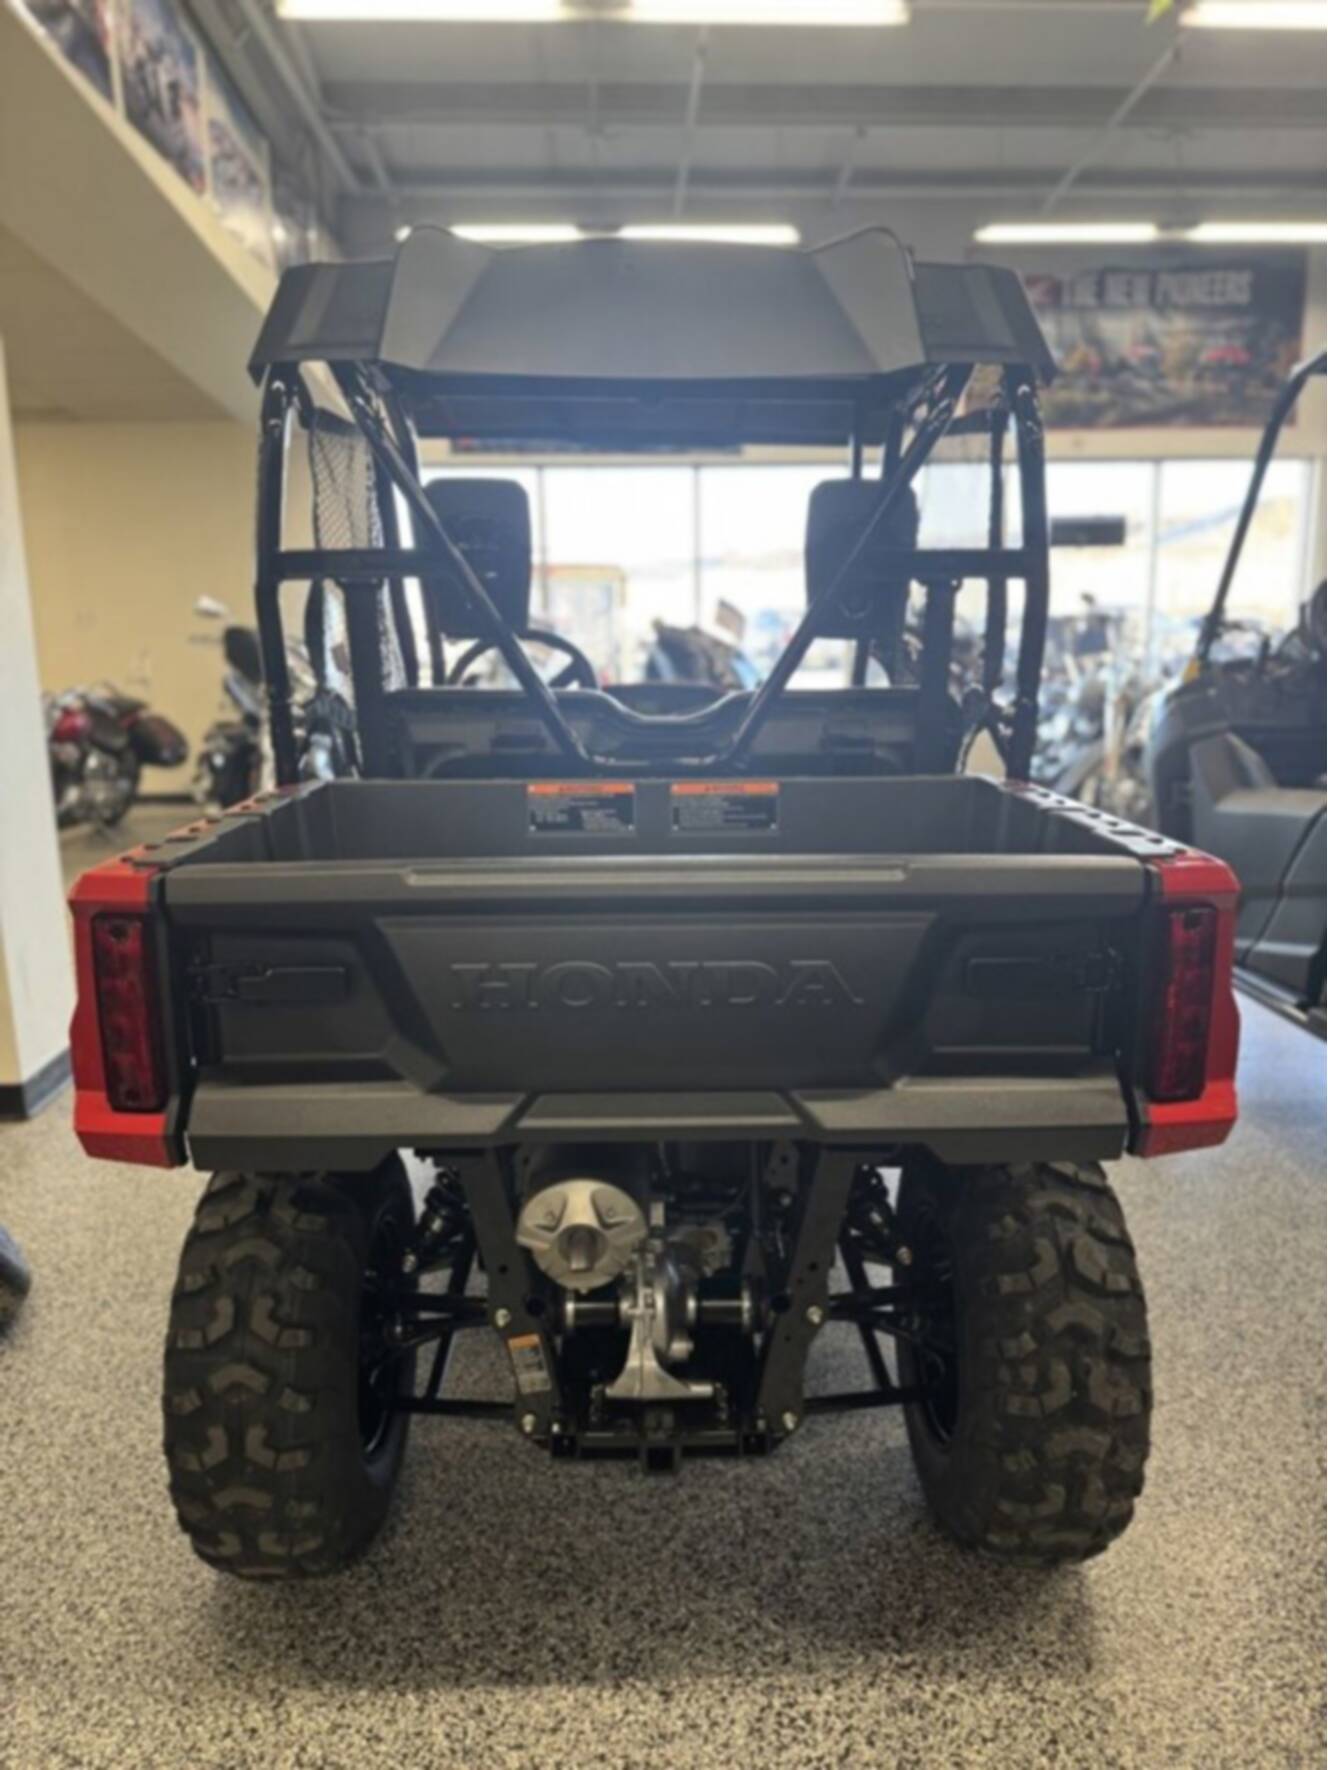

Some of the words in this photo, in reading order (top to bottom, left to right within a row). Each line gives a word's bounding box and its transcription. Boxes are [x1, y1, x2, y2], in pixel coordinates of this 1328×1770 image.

[1062, 273, 1097, 305] THE
[1104, 271, 1151, 305] NEW
[1156, 270, 1252, 305] PIONEERS
[451, 959, 865, 1008] HONDA
